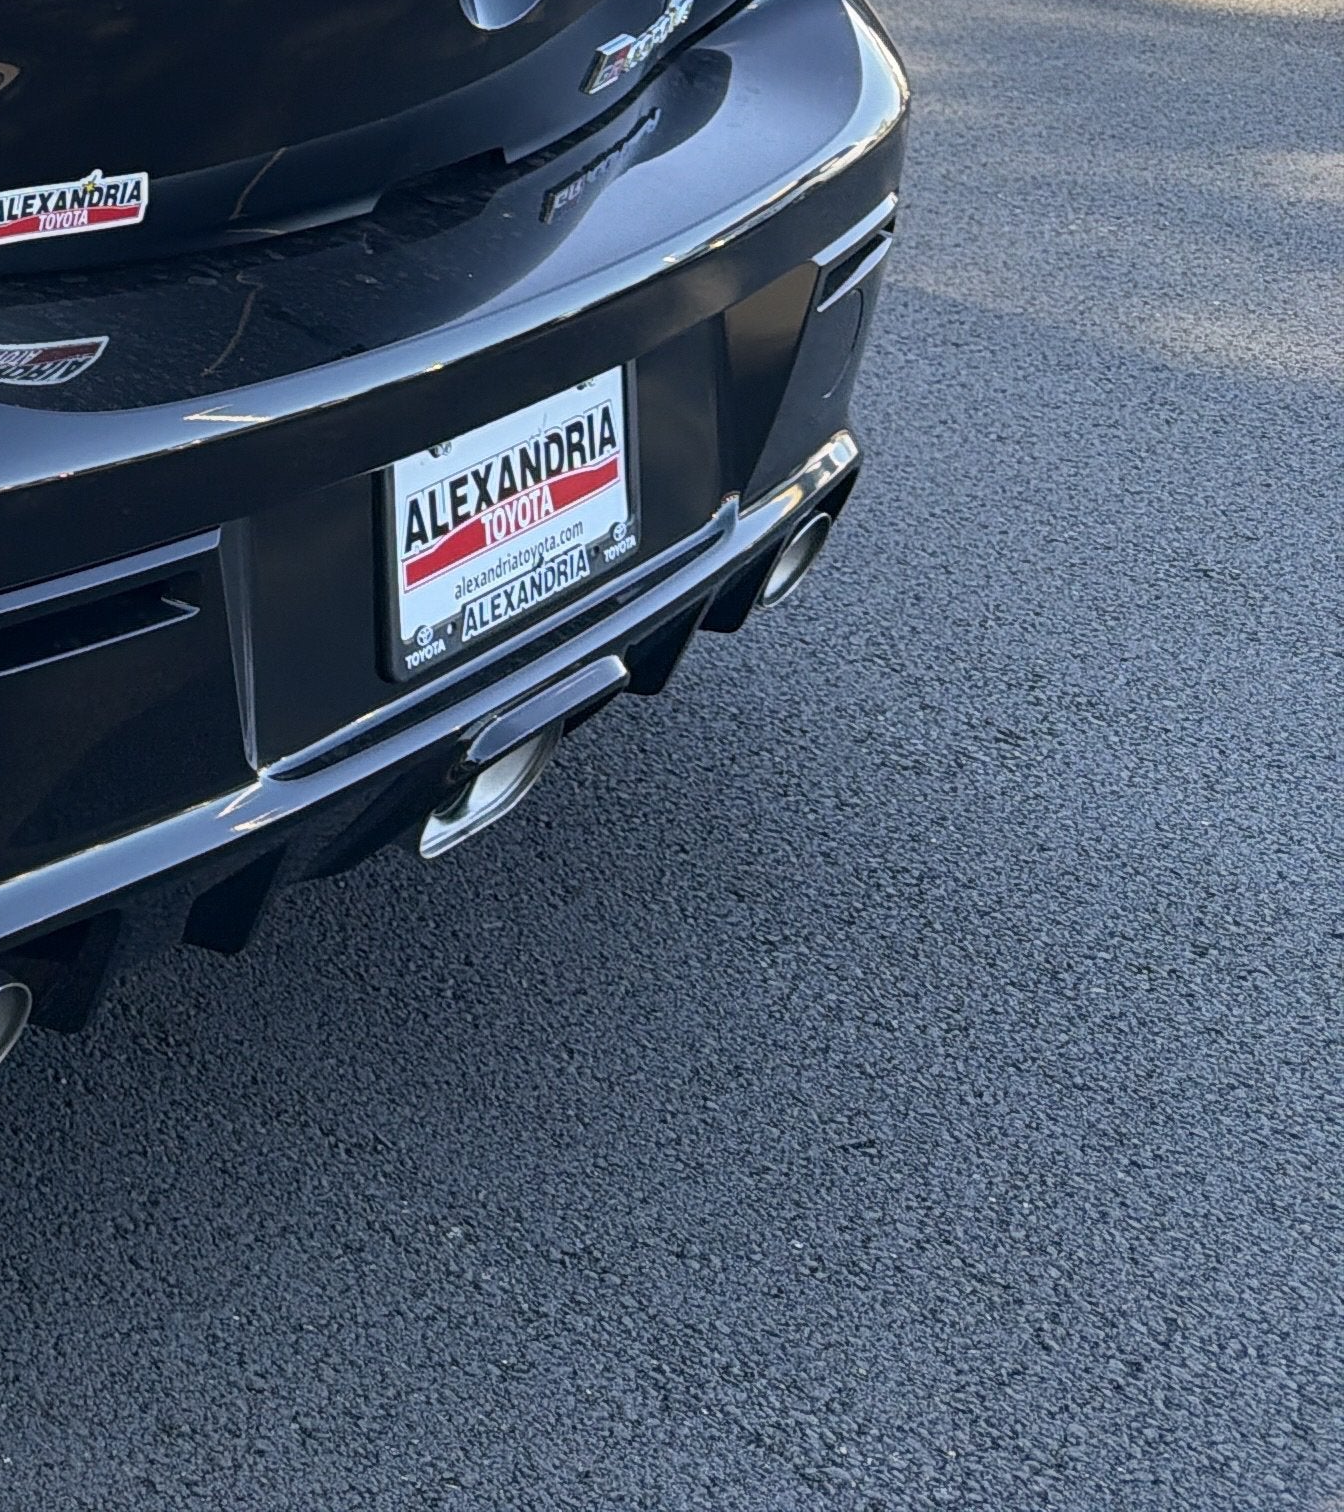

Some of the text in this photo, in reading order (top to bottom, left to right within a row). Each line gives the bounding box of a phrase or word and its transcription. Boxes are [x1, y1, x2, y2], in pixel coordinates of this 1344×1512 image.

[38, 209, 88, 232] TOYOTA
[403, 404, 618, 555] ALEXANDRIA
[479, 485, 556, 547] TOYOTA
[454, 519, 585, 601] alexandriatoyota.com
[603, 534, 637, 563] TOYOTA
[463, 547, 590, 639] ALEXANDRIA
[404, 638, 447, 670] TOYOTA
